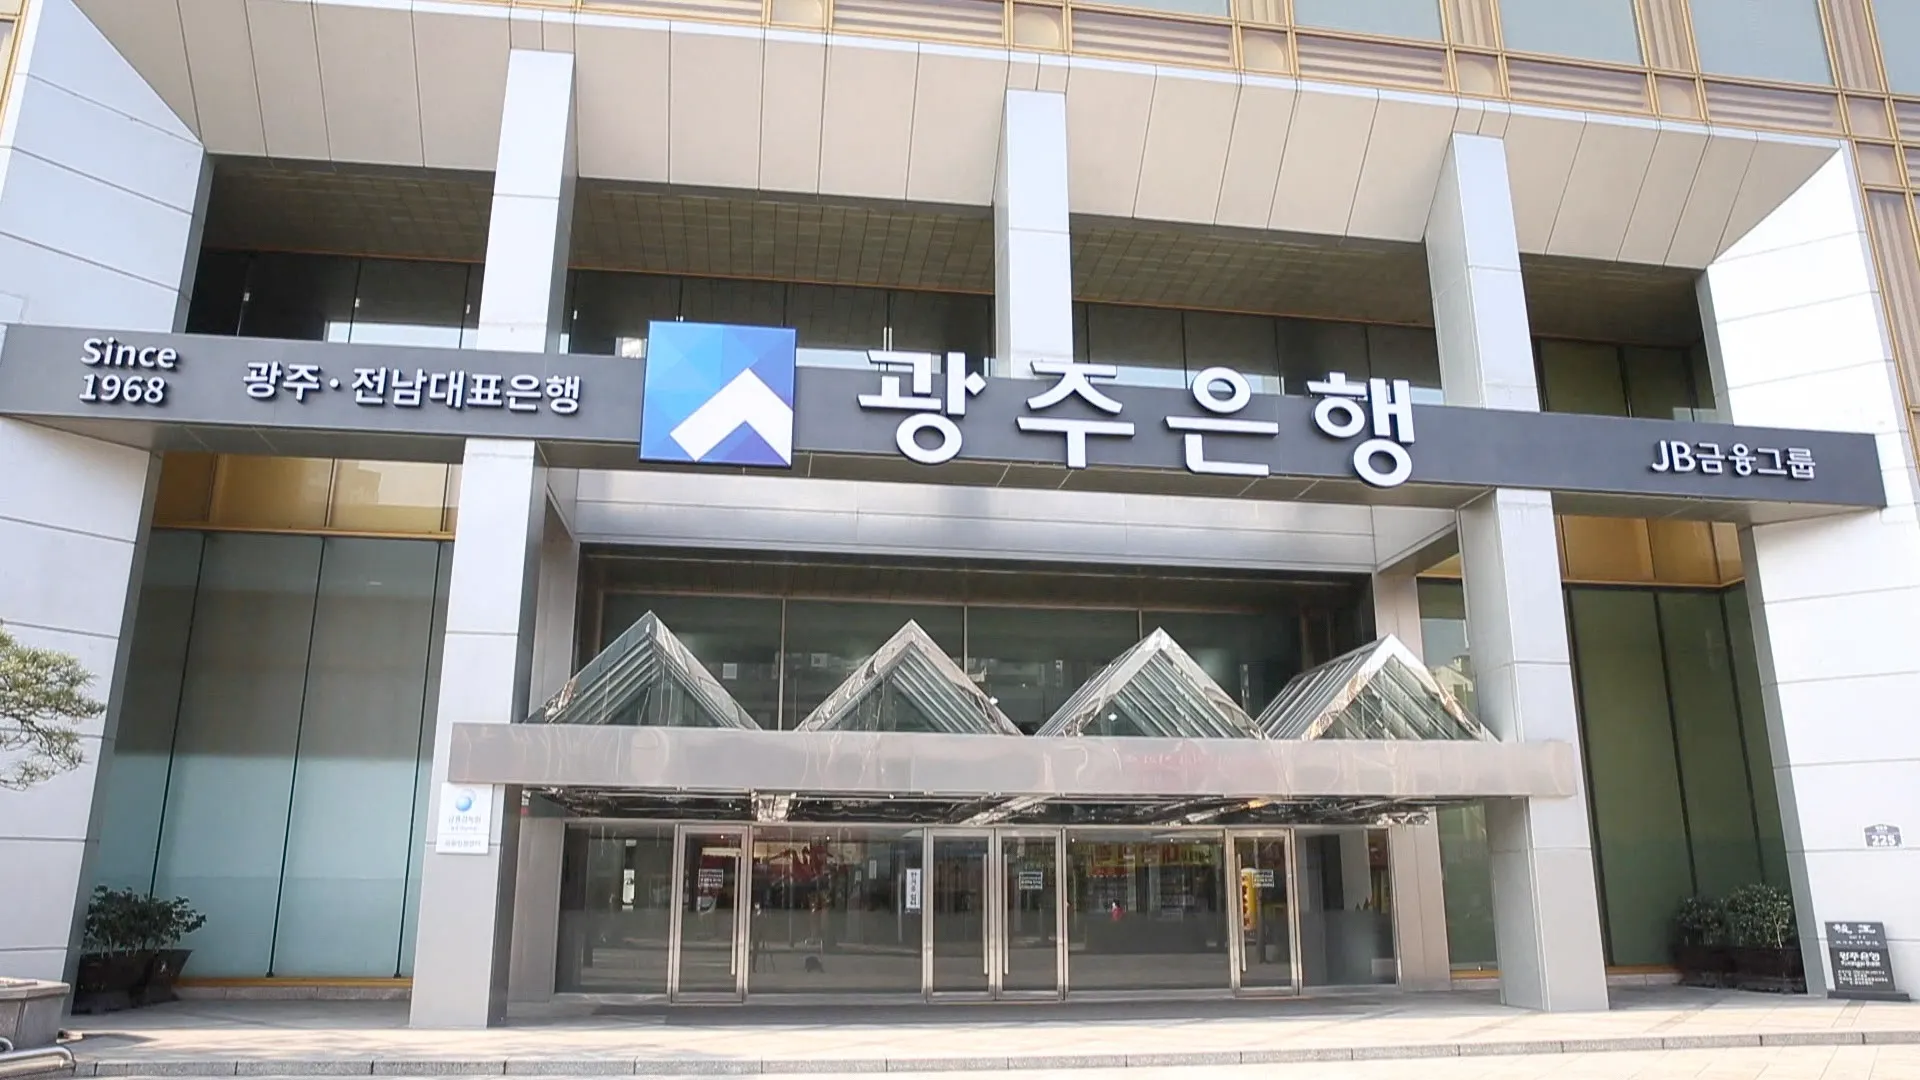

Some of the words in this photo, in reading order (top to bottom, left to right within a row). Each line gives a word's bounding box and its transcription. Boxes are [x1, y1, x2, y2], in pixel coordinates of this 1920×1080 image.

[80, 337, 177, 368] Since
[79, 373, 165, 404] 1968
[858, 350, 1415, 488] 광주은행
[1651, 439, 1816, 479] JB금융그룹
[1871, 834, 1896, 847] 225
